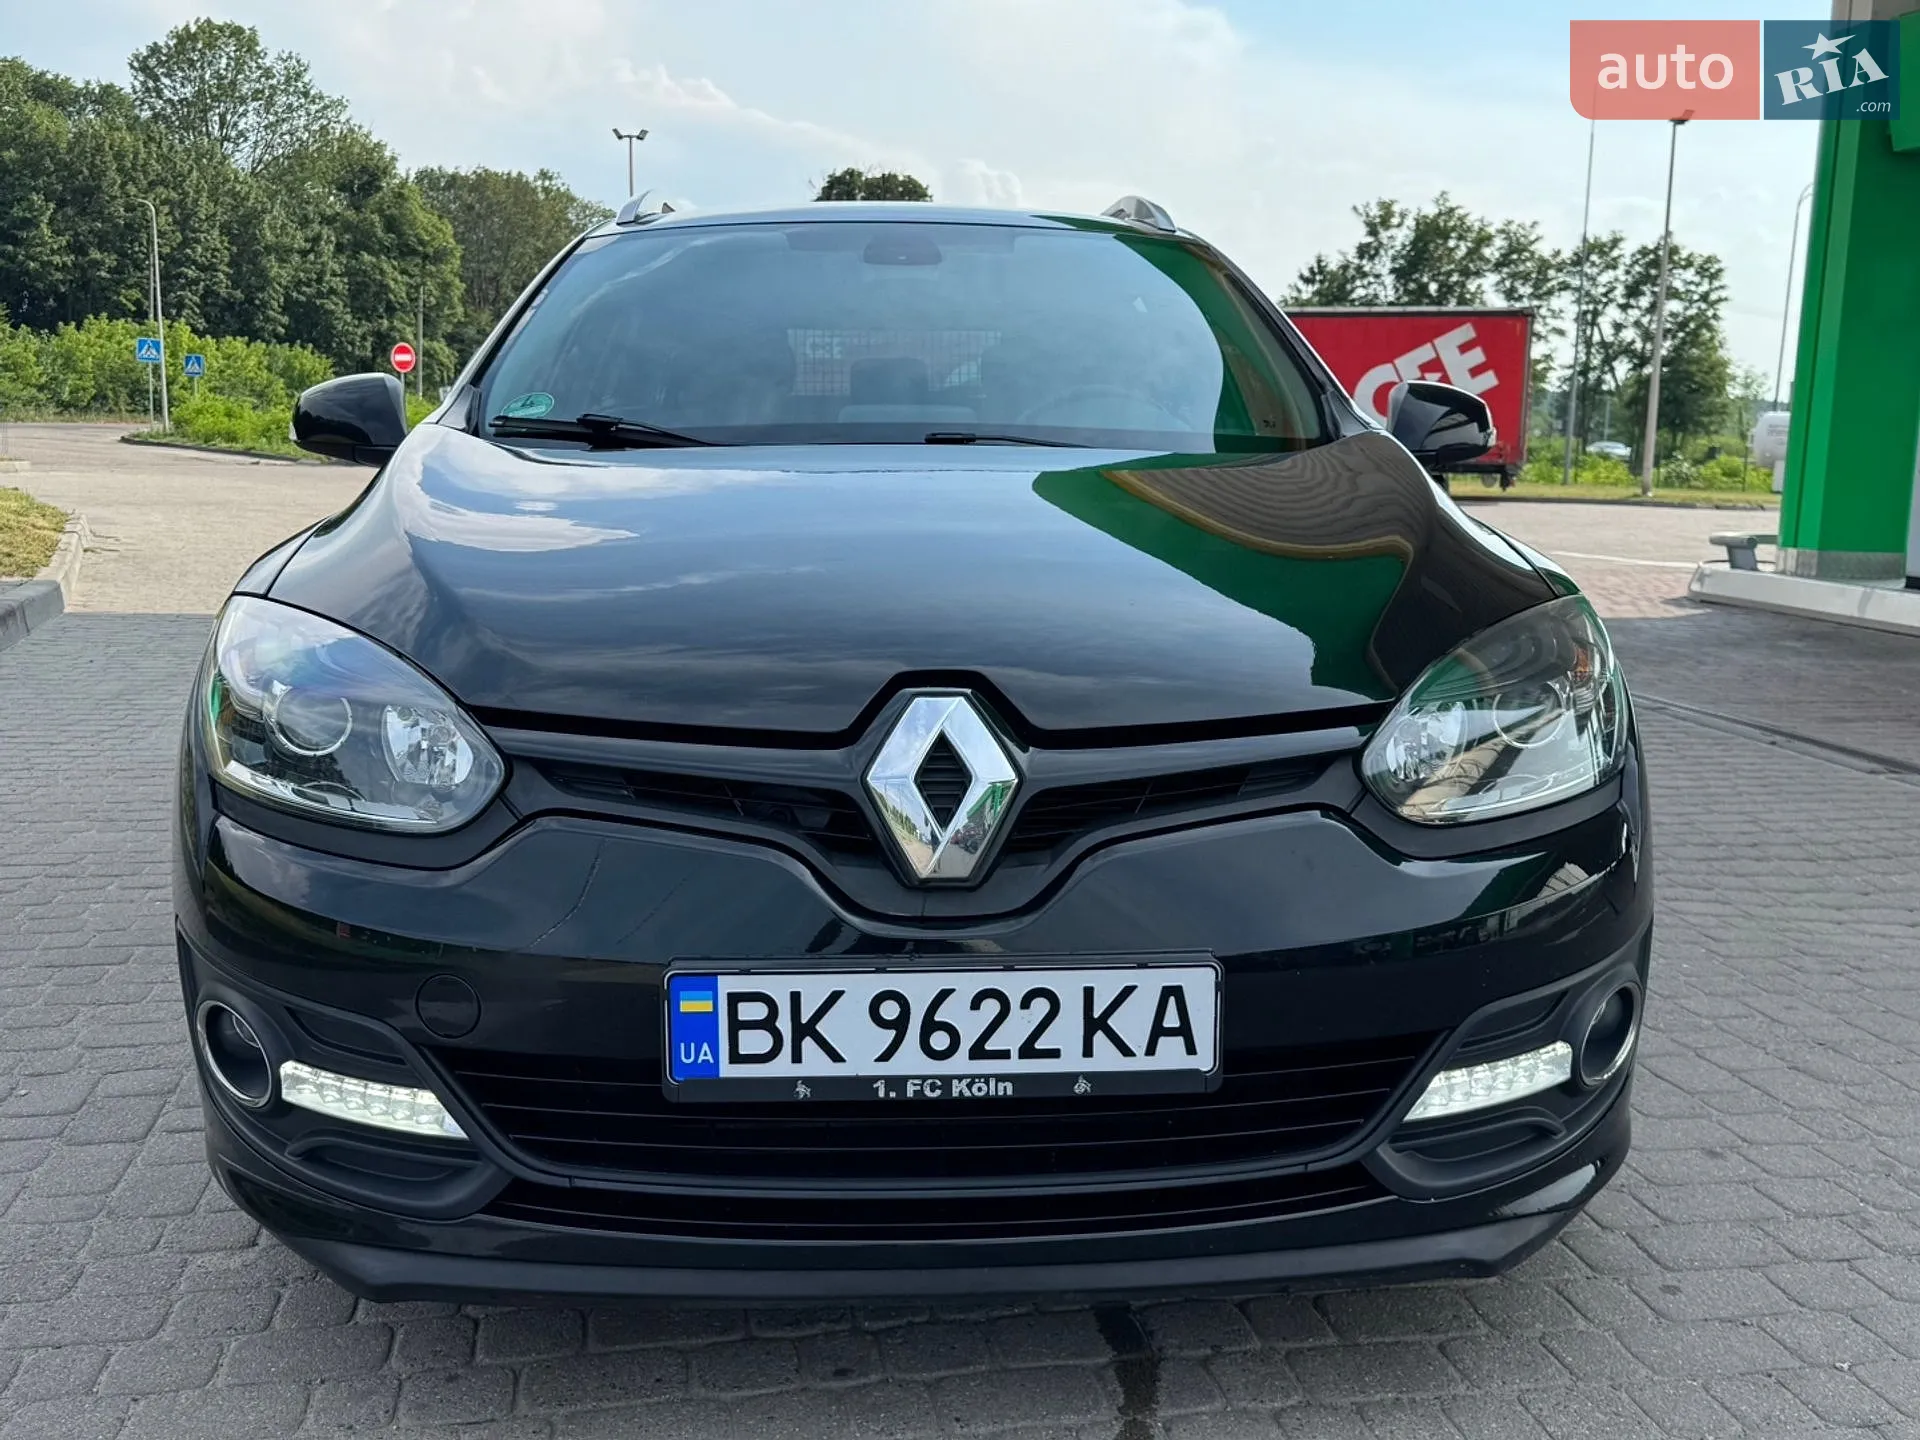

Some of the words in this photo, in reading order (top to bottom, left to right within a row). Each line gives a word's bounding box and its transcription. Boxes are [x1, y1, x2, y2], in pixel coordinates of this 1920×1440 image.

[726, 989, 847, 1065] BK
[868, 986, 1061, 1063] 9622
[1082, 985, 1198, 1058] KA
[680, 1042, 713, 1064] UA
[873, 1079, 896, 1098] 1.
[906, 1079, 942, 1097] FC
[952, 1077, 1014, 1097] Köln
